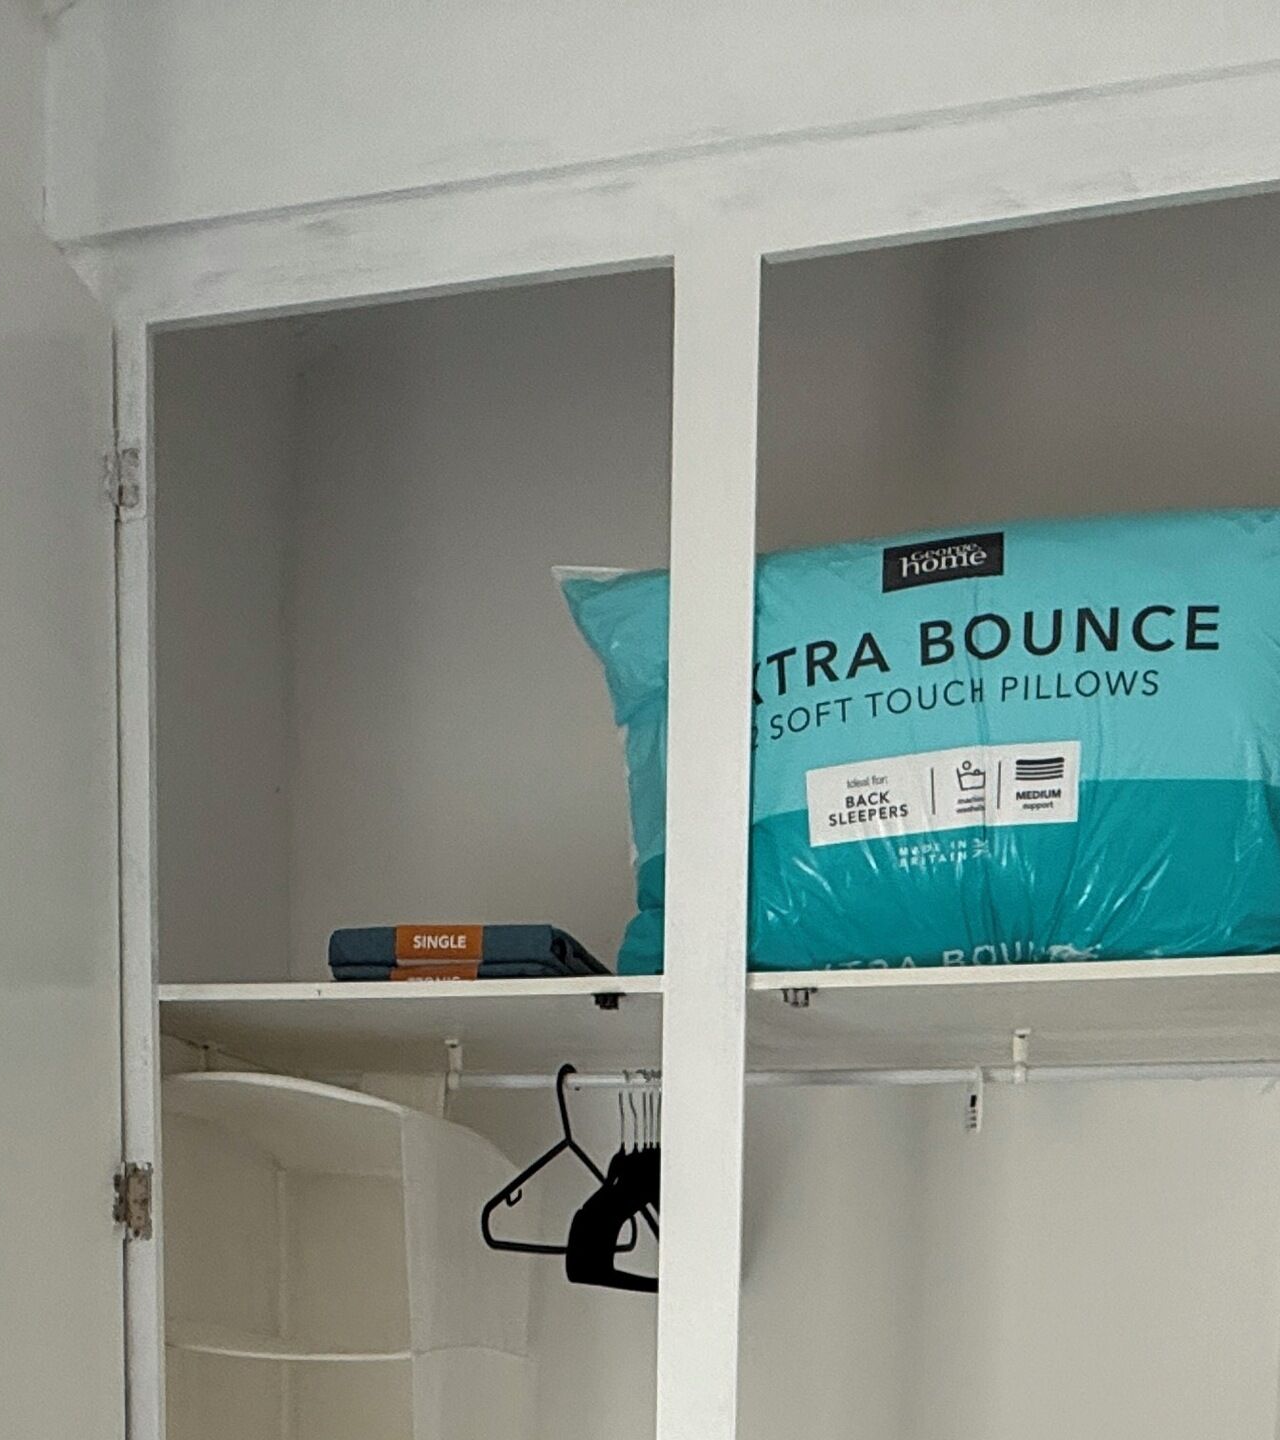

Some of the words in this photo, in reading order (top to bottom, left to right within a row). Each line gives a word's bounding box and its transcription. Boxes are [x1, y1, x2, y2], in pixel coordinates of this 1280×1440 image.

[900, 550, 988, 578] home
[919, 605, 1220, 667] BOUNCE
[770, 697, 852, 740] SOFT
[864, 677, 984, 718] TOUCH
[1001, 669, 1160, 702] PILLOWS
[845, 790, 890, 808] BACK
[1015, 788, 1062, 800] MEDIUM
[828, 804, 909, 827] SLEEPERS
[1022, 801, 1054, 811] support
[413, 934, 467, 949] SINGLE
